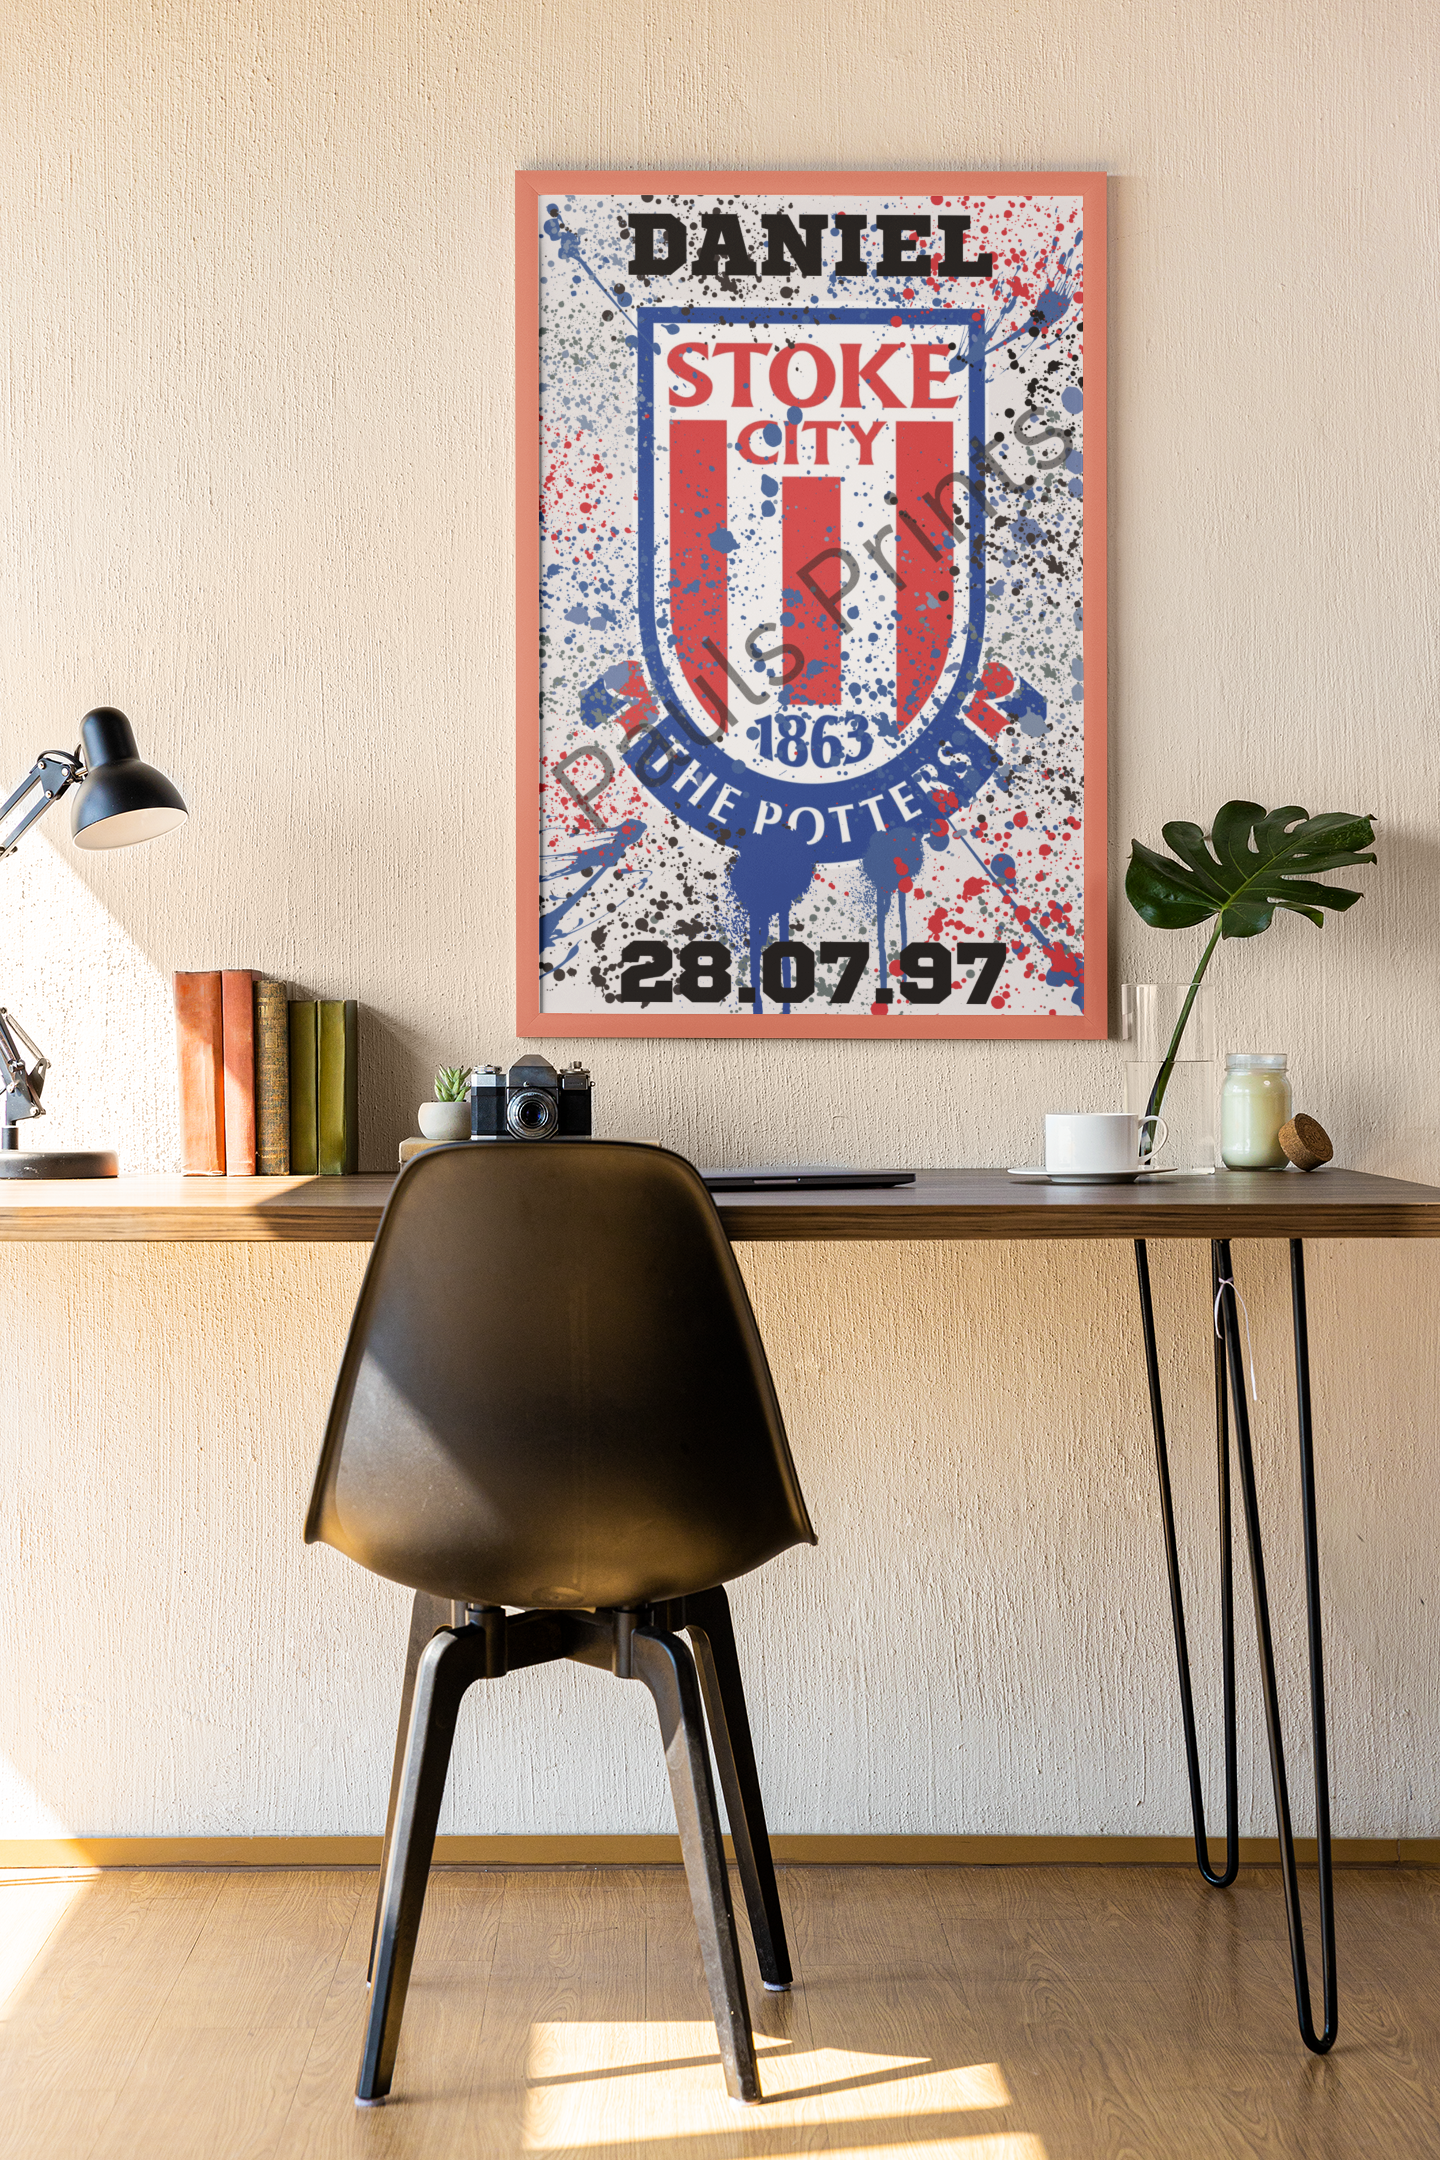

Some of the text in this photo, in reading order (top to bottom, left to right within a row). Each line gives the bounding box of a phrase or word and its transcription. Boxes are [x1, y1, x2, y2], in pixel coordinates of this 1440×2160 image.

[628, 213, 992, 277] DANIEL
[666, 341, 960, 409] STOKE
[736, 420, 888, 465] CITY
[754, 714, 874, 769] 1863
[651, 734, 973, 846] THE POTTERS
[620, 940, 1007, 1005] 28.07.97
